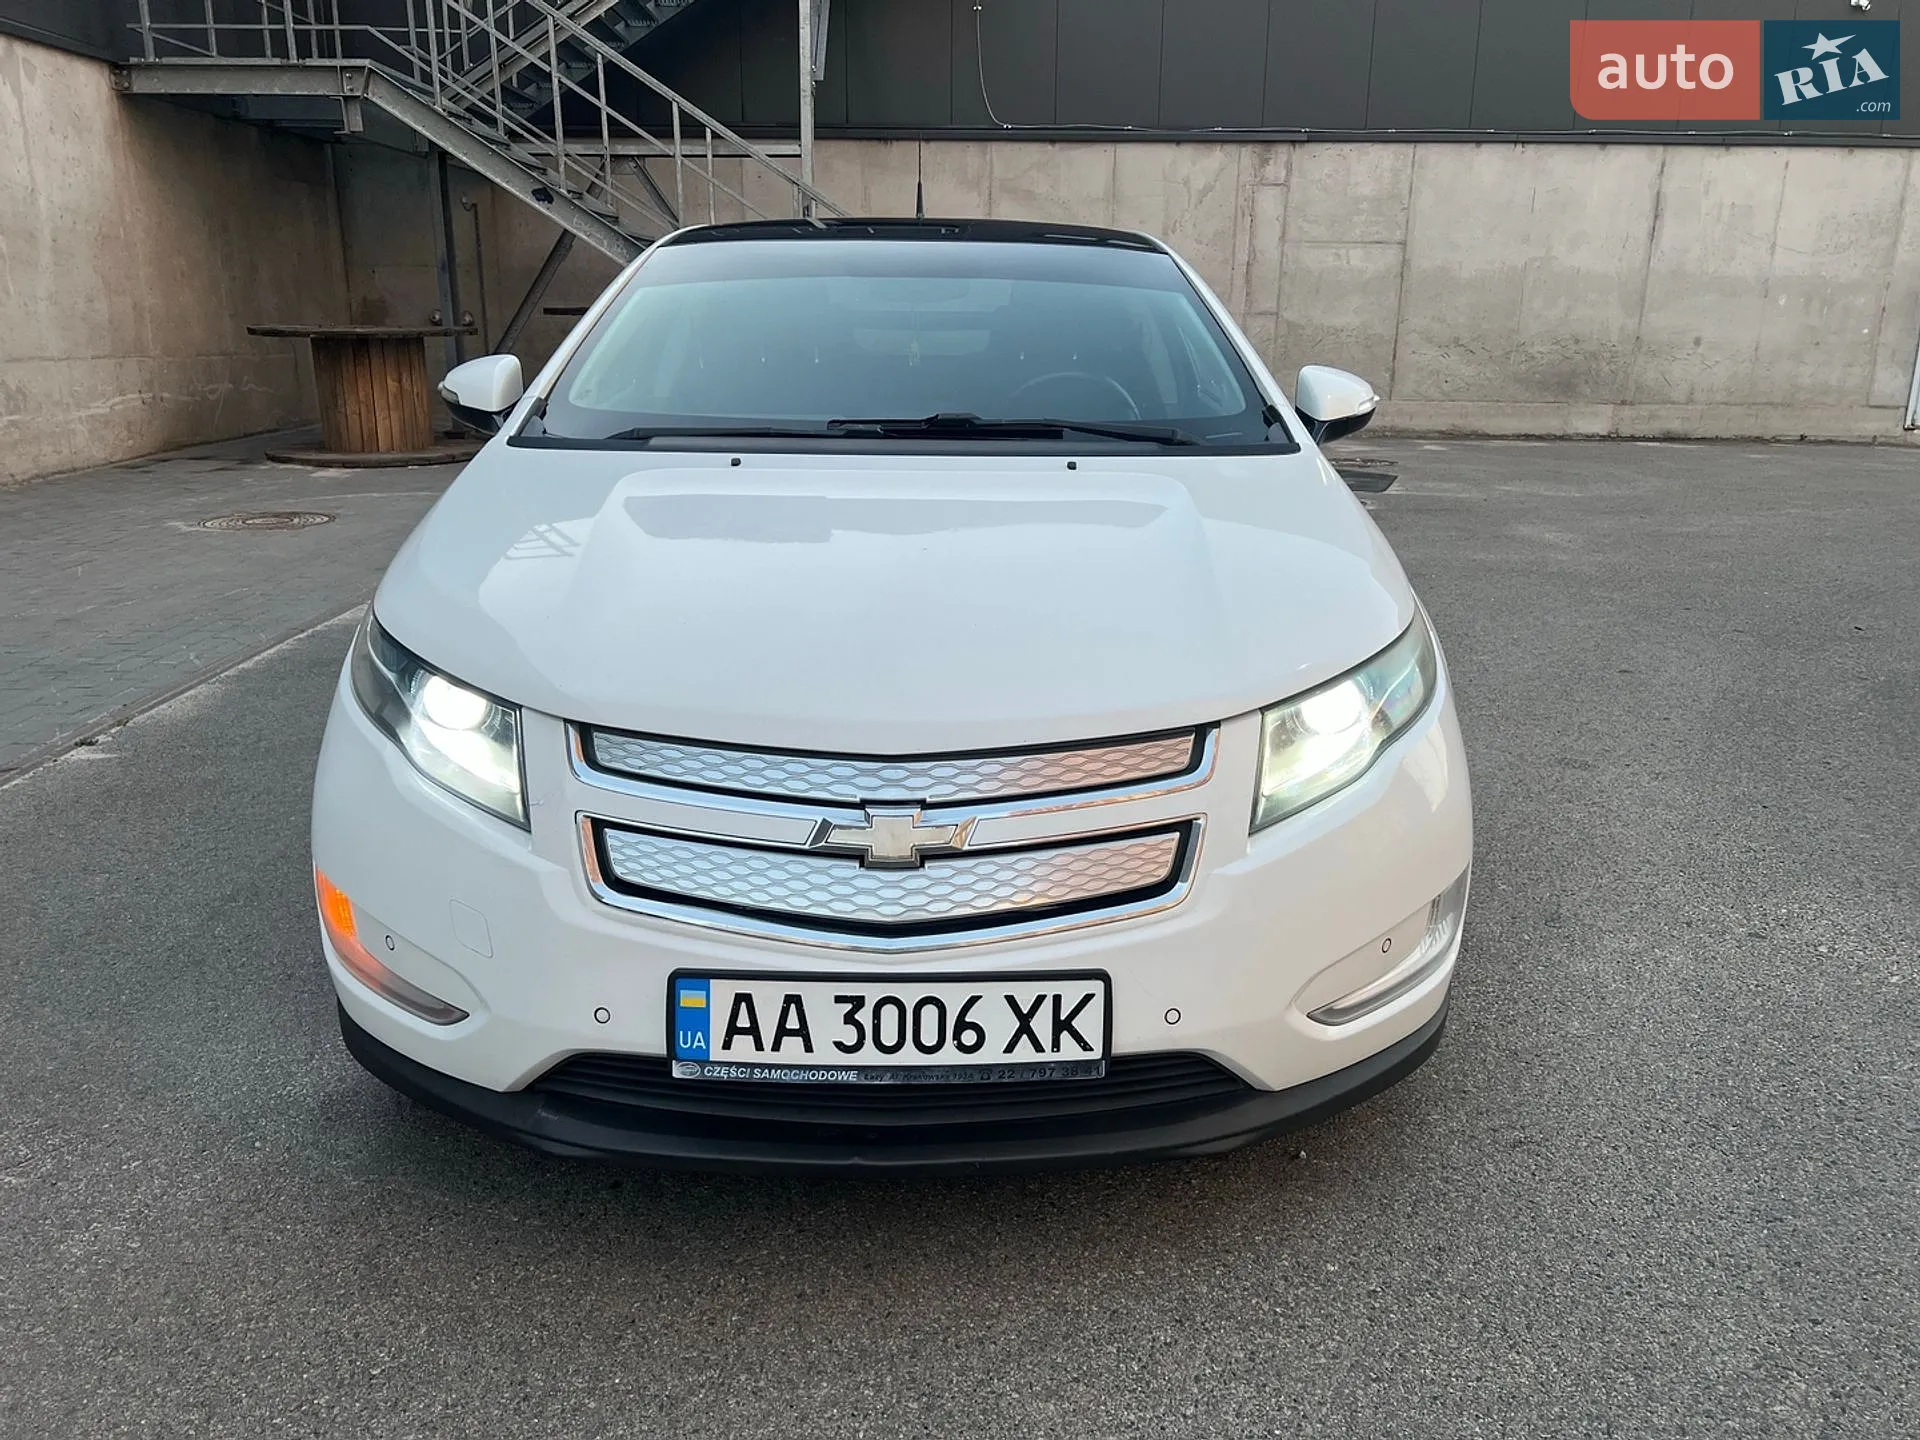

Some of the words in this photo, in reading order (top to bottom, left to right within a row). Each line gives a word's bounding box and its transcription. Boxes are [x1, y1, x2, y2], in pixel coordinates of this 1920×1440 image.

[721, 992, 814, 1053] AA
[832, 994, 986, 1055] 3006
[1002, 993, 1096, 1054] XK
[679, 1030, 706, 1049] UA
[704, 1065, 750, 1079] CZĘŚCI
[753, 1068, 858, 1081] SAMOCHODOWE
